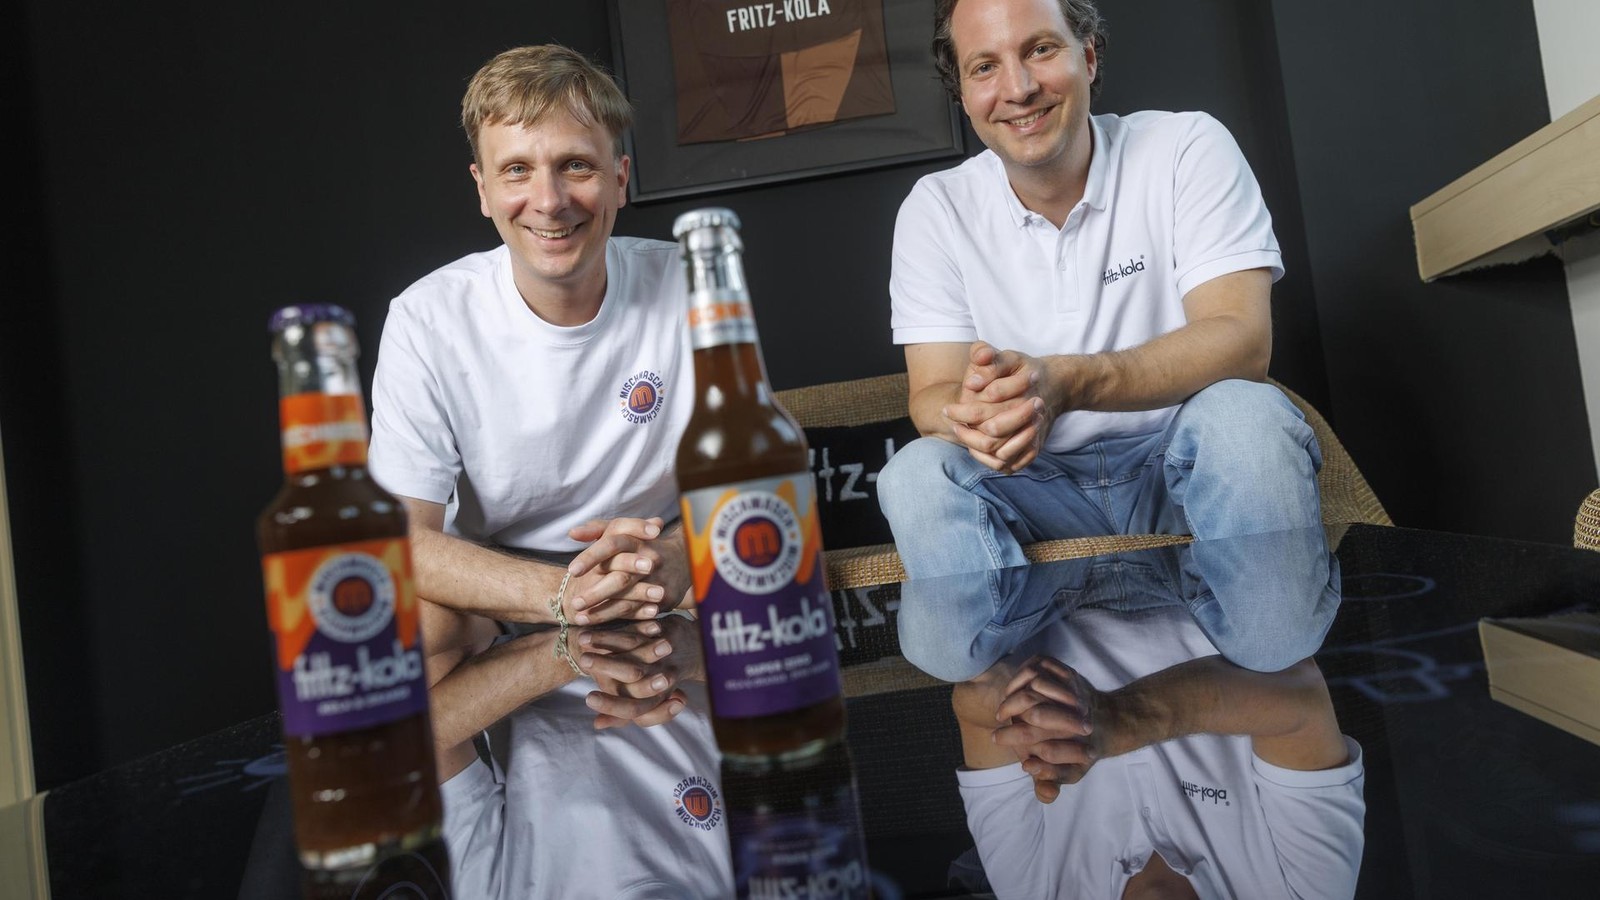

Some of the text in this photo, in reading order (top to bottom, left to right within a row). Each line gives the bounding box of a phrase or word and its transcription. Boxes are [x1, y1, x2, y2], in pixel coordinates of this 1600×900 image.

[726, 0, 831, 33] FRITZ-KOLA
[1103, 258, 1145, 286] fritz-kola
[711, 598, 828, 656] fritz-kola
